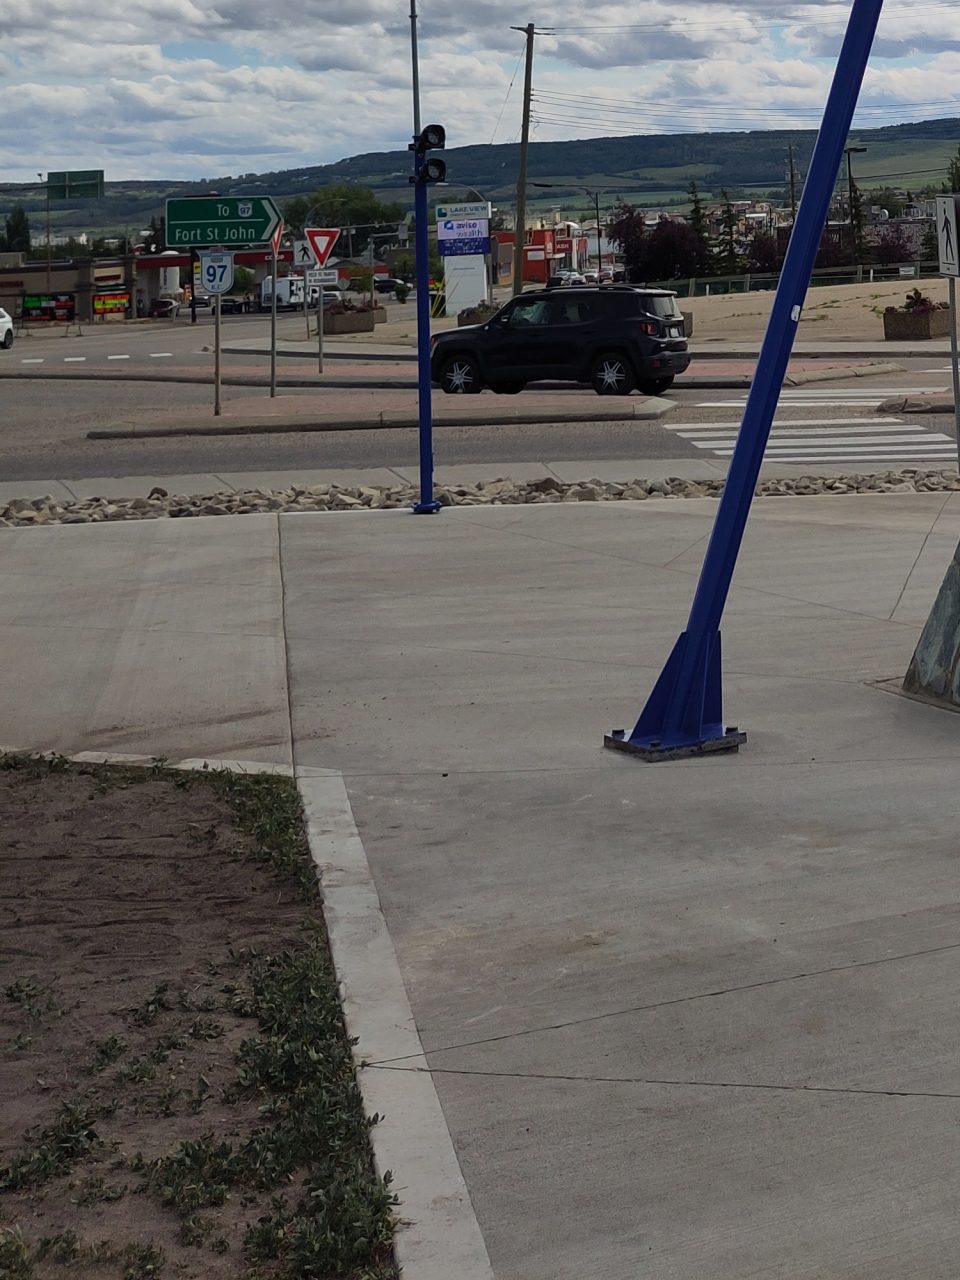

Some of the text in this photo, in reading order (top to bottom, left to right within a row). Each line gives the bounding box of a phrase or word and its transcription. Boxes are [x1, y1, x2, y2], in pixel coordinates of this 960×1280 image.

[216, 204, 251, 217] To 97
[456, 221, 477, 229] aviso
[175, 226, 255, 241] Fort St John
[206, 264, 228, 283] 97
